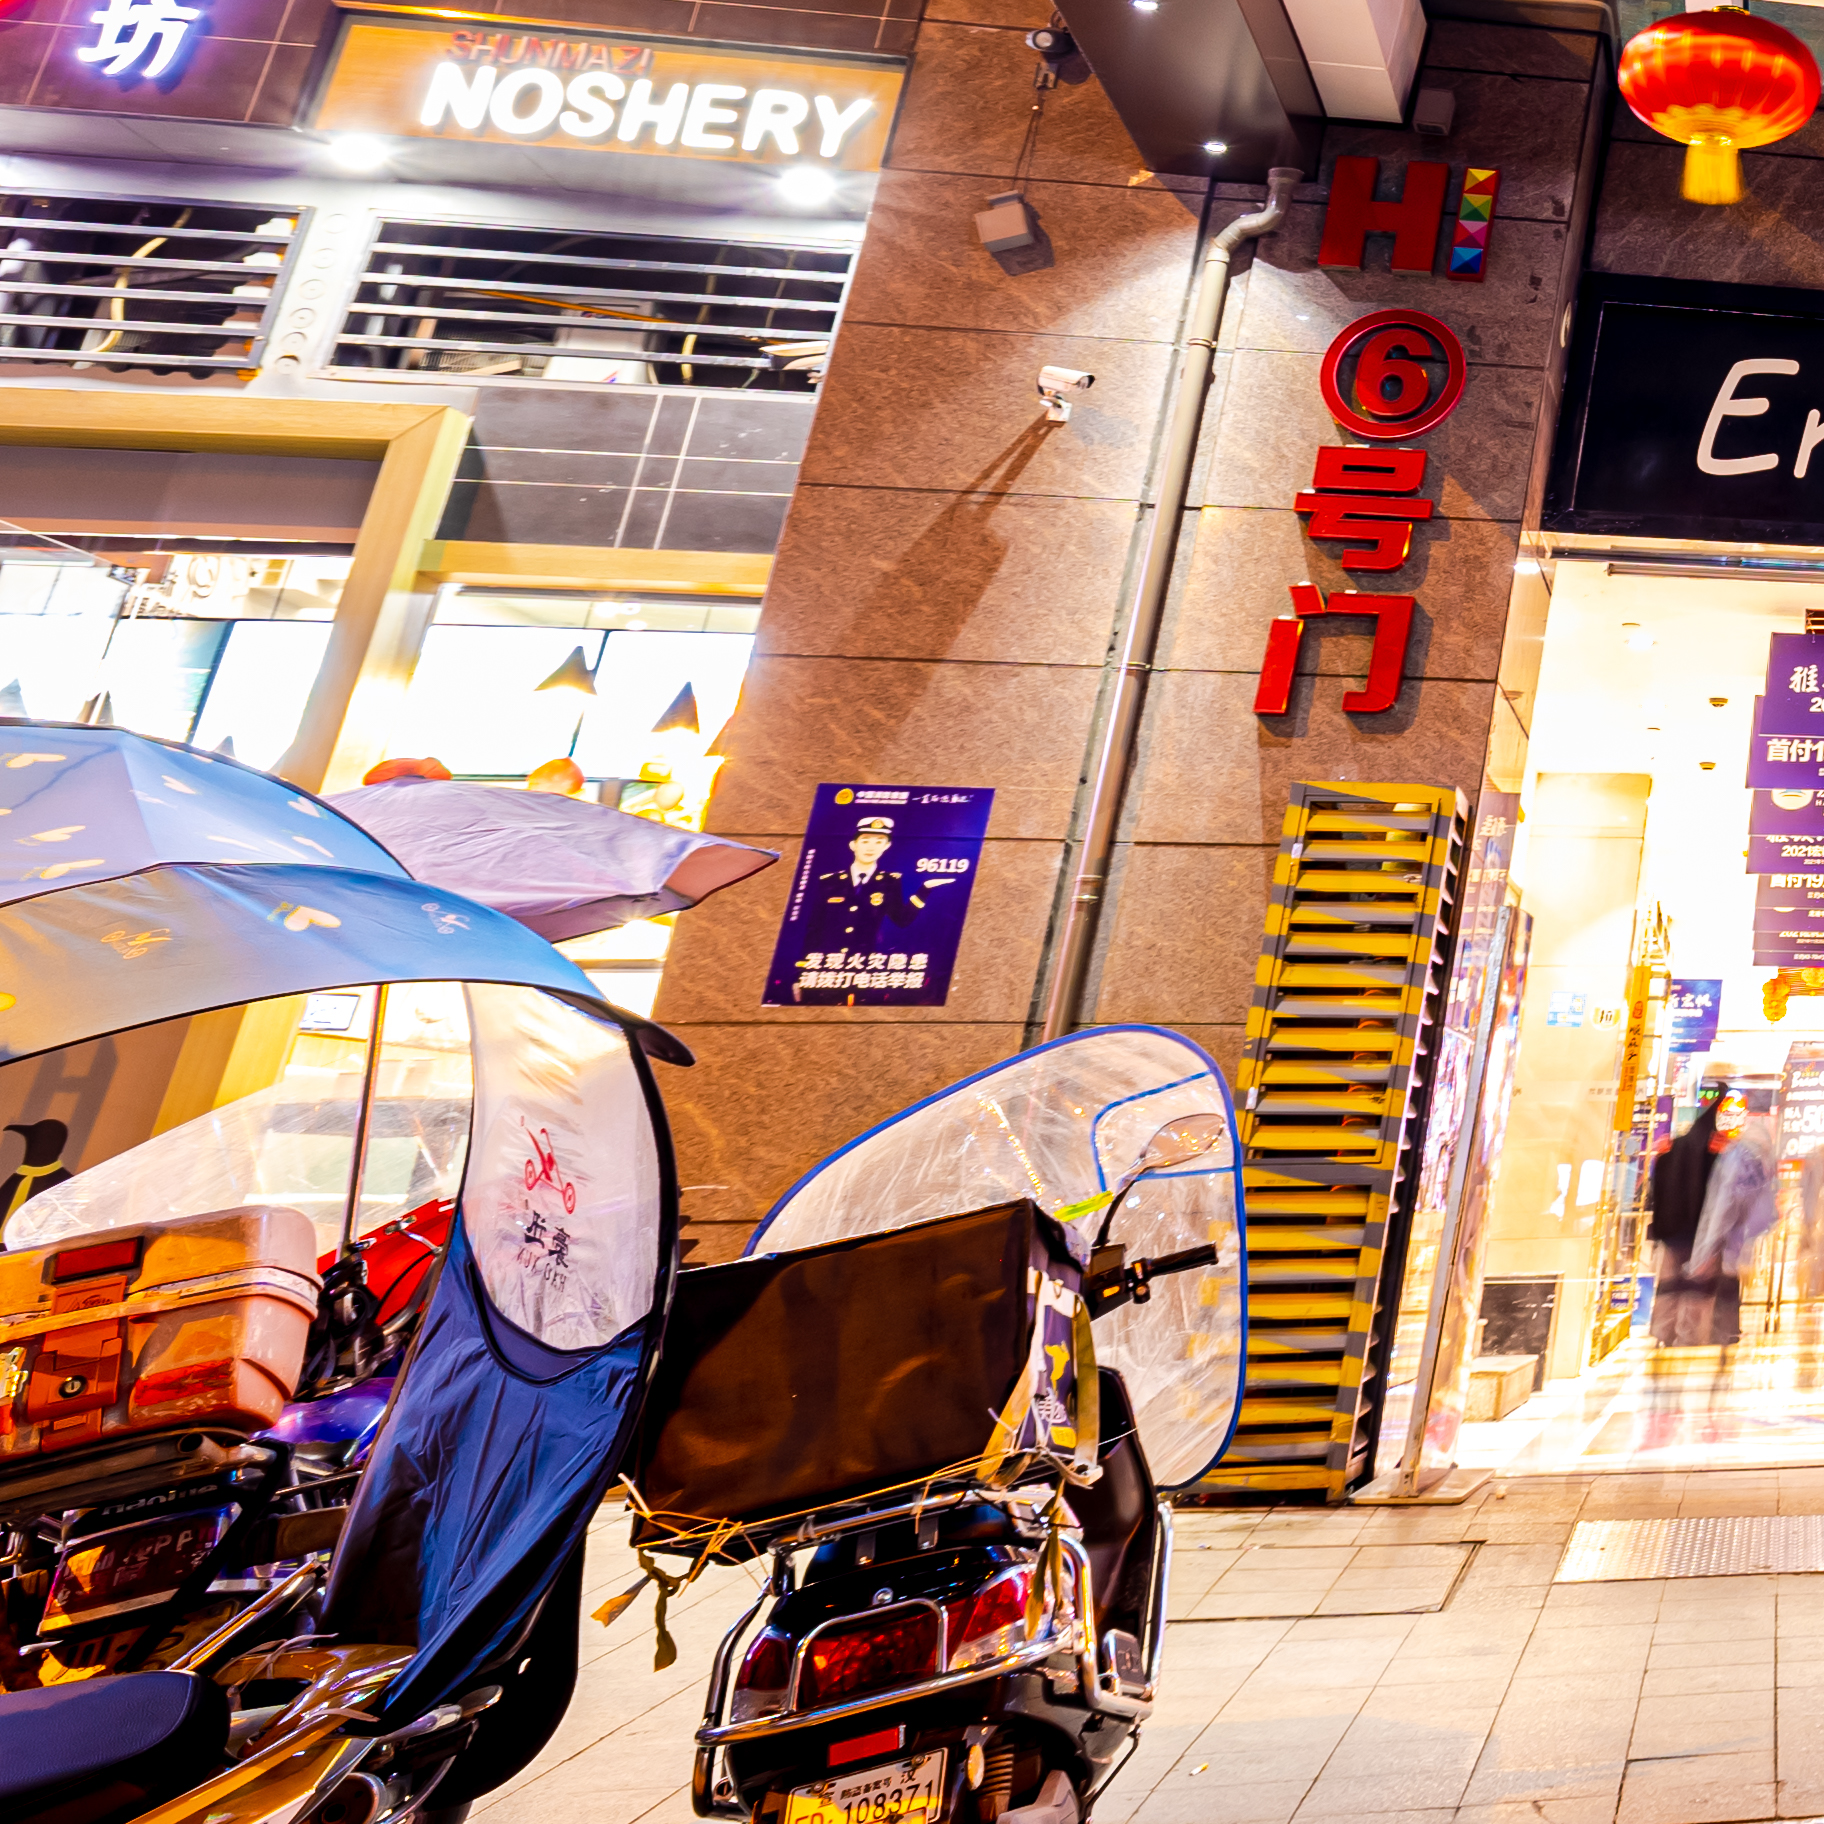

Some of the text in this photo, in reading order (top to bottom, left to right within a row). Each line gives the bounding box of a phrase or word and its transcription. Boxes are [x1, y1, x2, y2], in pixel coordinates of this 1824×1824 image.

[445, 29, 654, 80] SHUNMAZI
[420, 60, 873, 158] NOSHERY
[915, 857, 970, 874] 96119
[803, 952, 929, 971] 发现火灾隐患
[798, 971, 926, 990] 请拨打电话举报
[843, 1778, 935, 1824] 108371
